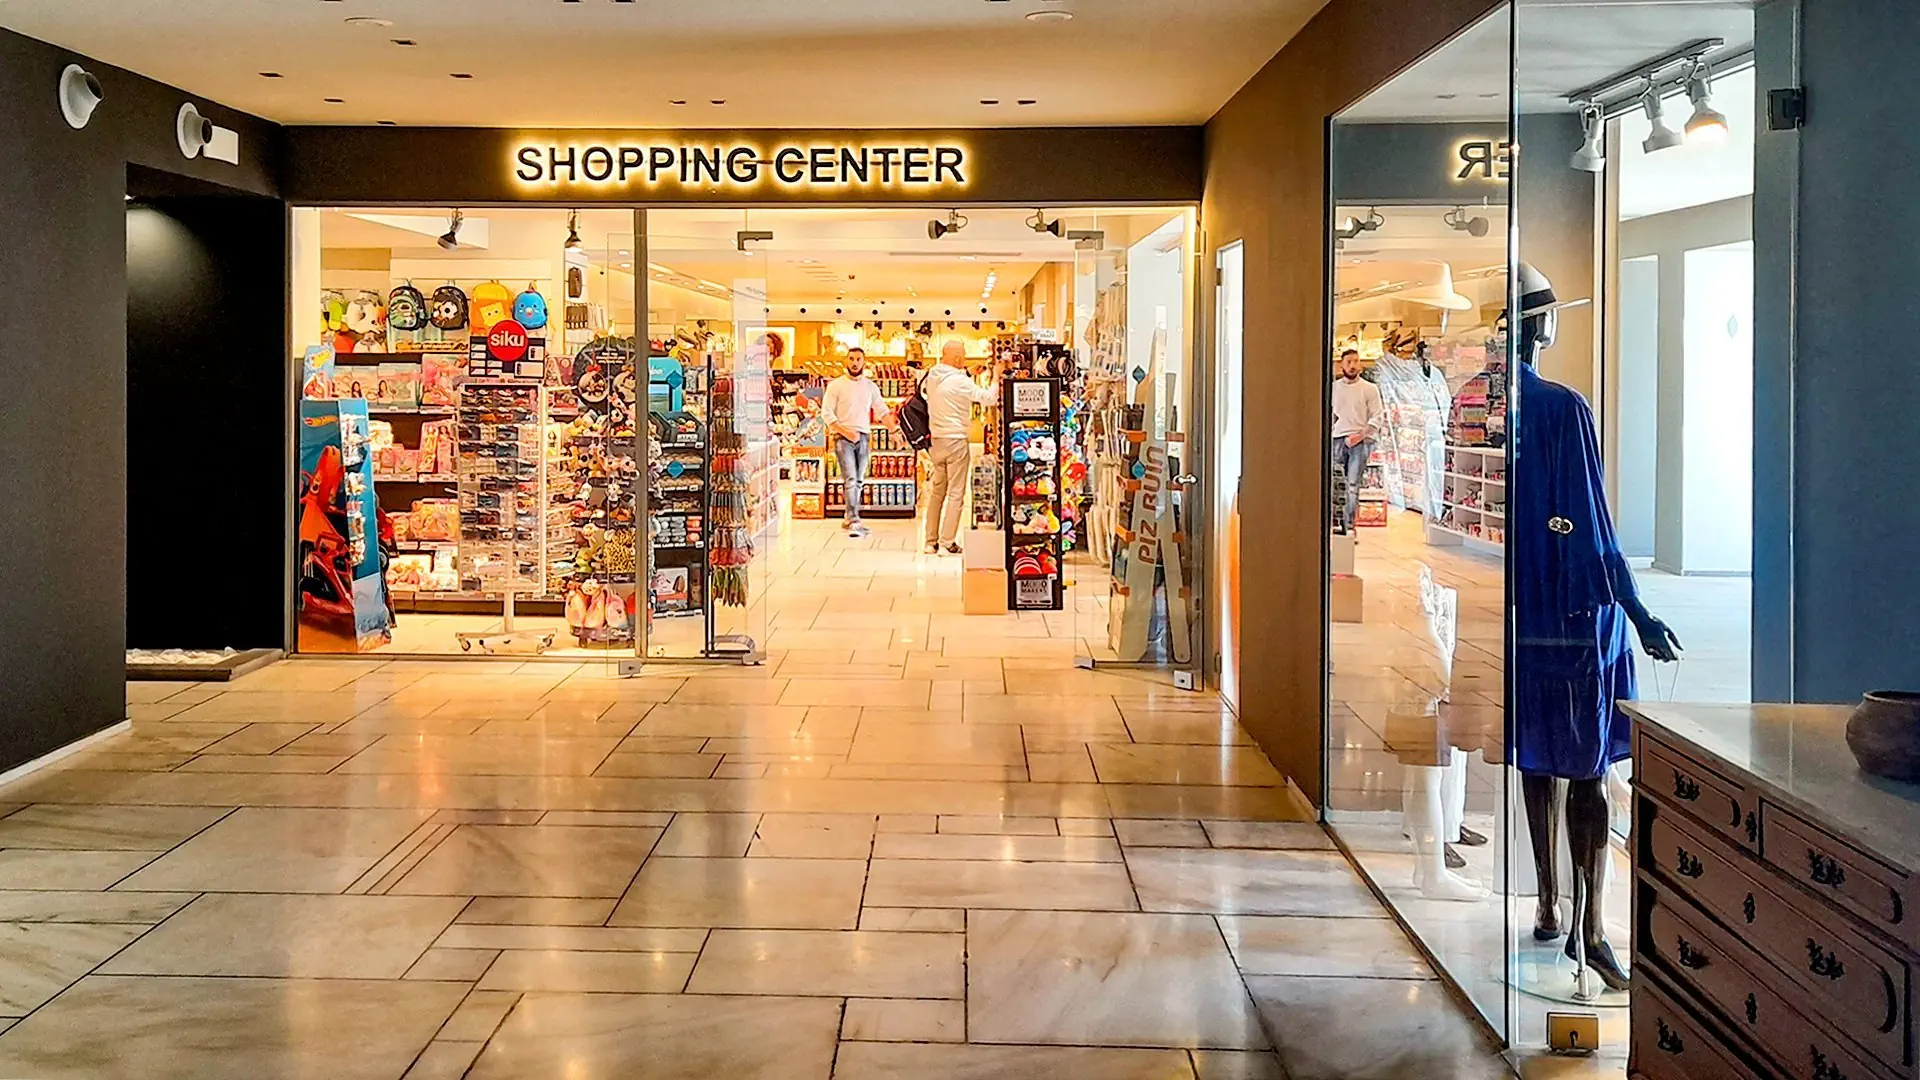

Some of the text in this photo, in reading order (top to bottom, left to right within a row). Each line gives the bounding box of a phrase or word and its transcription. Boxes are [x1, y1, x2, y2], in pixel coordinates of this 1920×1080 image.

[516, 147, 965, 183] SHOPPING CENTER
[490, 330, 525, 347] siku
[1138, 519, 1158, 564] PIZ
